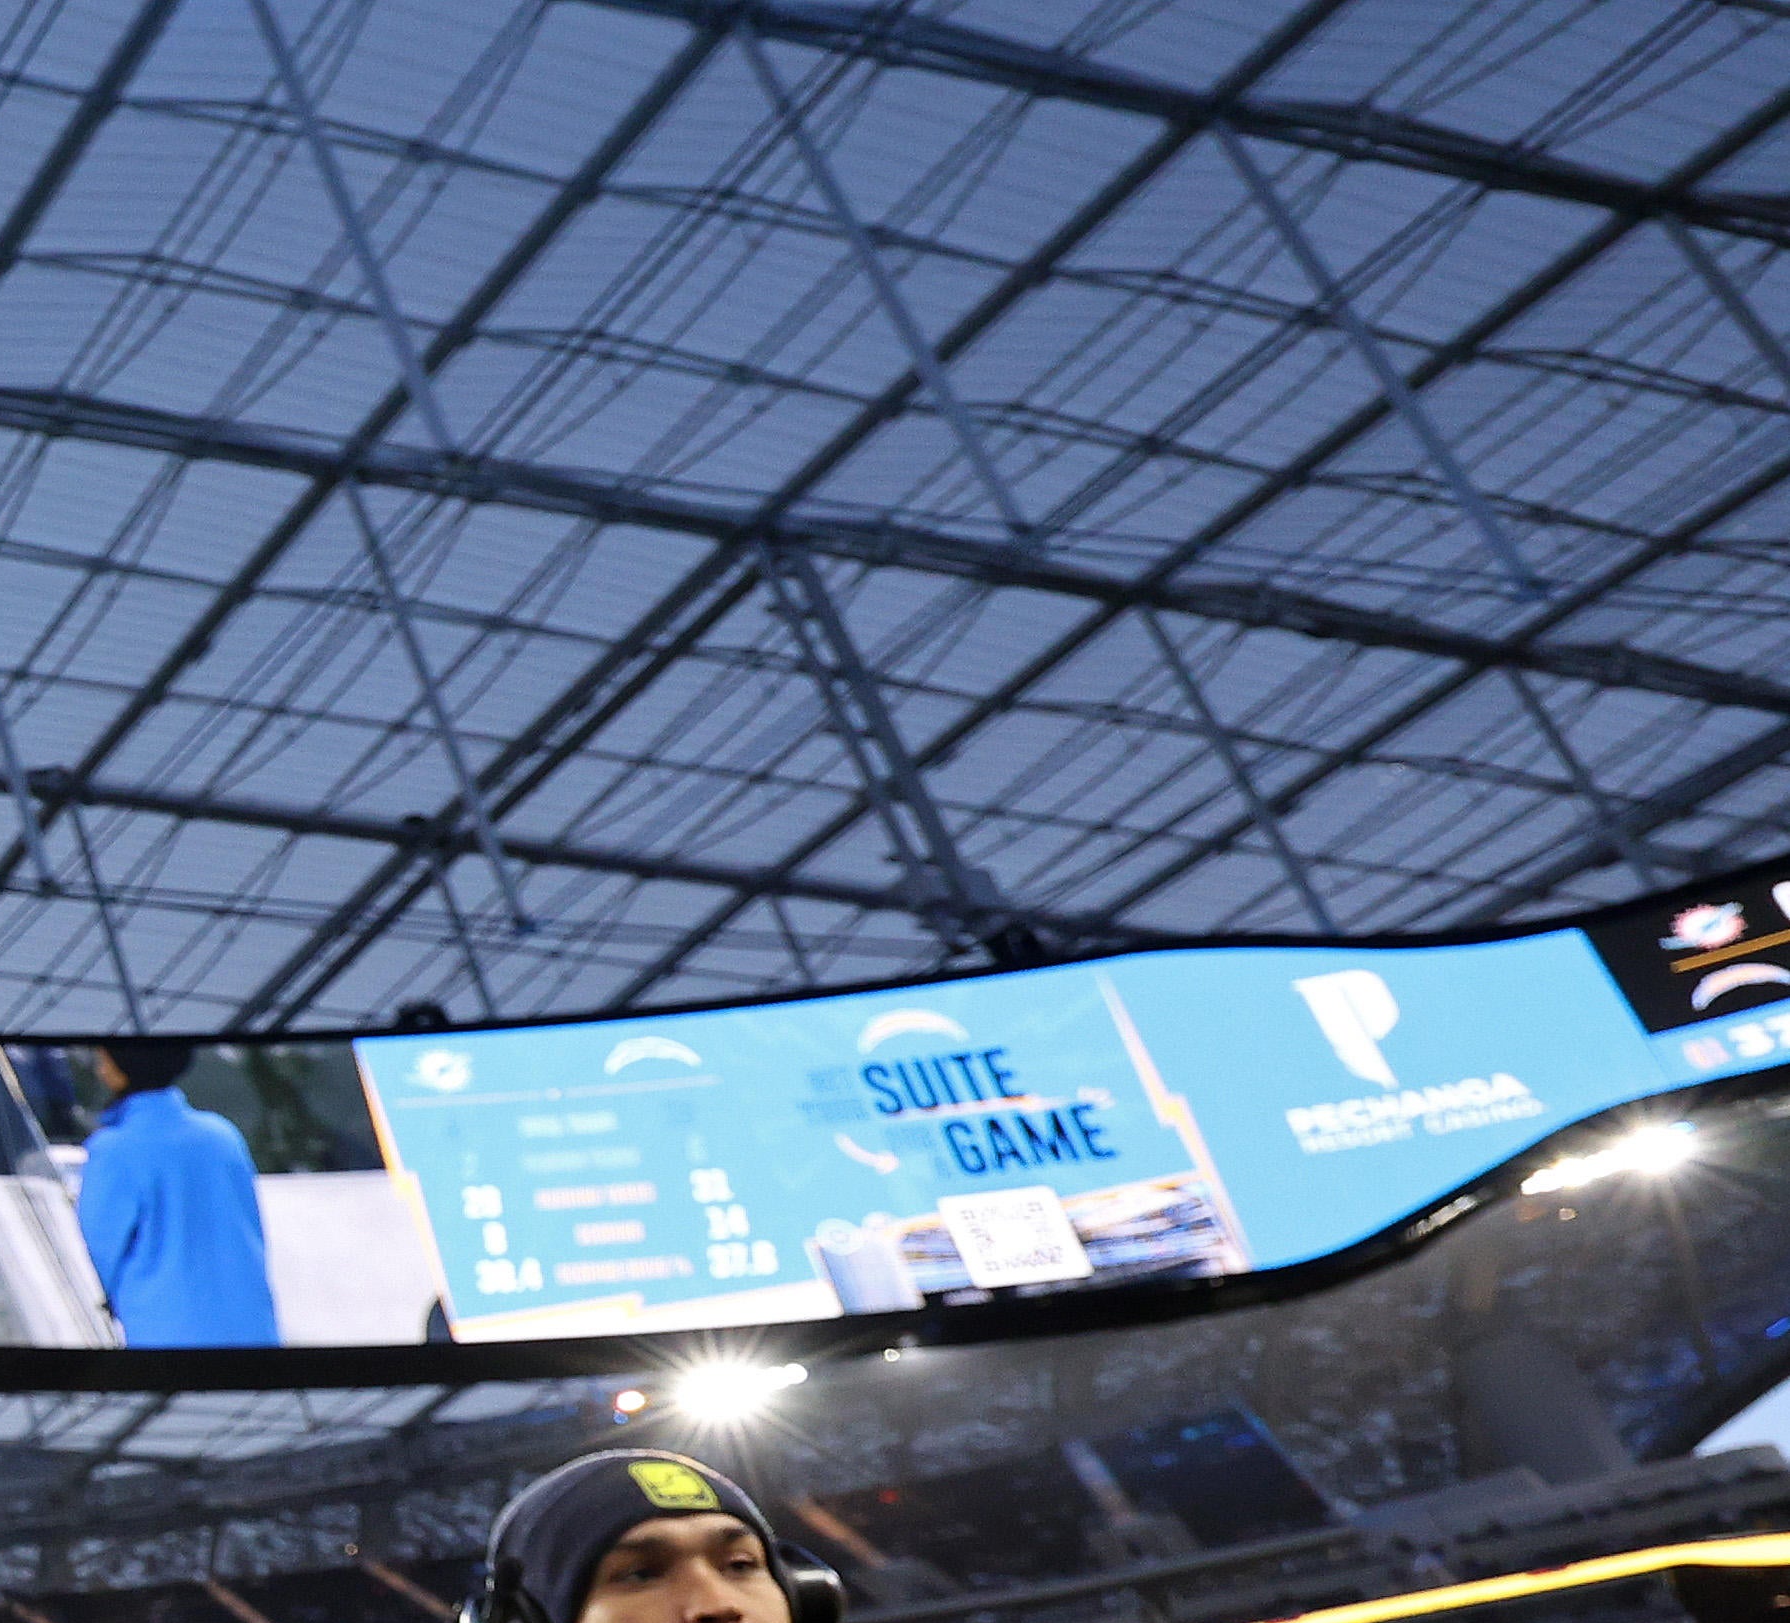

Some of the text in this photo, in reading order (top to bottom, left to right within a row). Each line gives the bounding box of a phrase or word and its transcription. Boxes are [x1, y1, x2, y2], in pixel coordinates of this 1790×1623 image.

[860, 1048, 1024, 1116] SUITE
[1285, 1072, 1531, 1136] PECHANGA
[942, 1104, 1119, 1175] GAME
